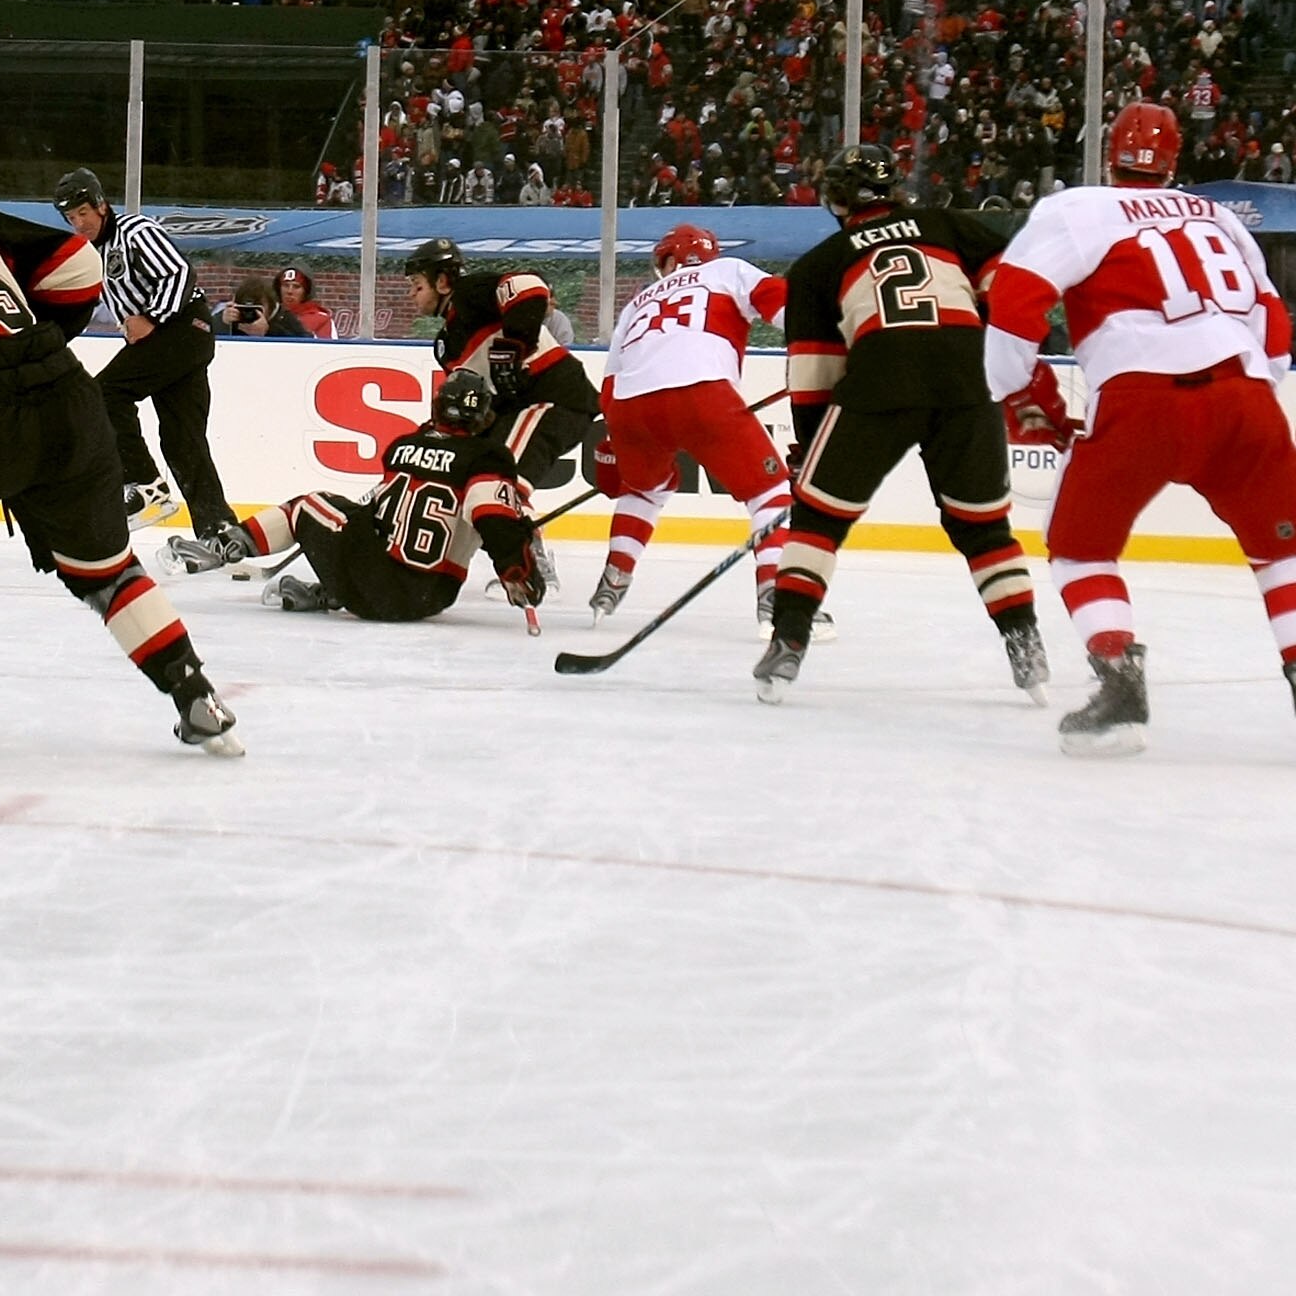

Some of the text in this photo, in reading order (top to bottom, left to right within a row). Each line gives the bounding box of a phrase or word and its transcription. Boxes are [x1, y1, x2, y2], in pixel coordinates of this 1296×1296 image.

[876, 162, 889, 179] 2
[1137, 149, 1154, 164] 18
[850, 219, 921, 250] KEITH
[284, 268, 296, 282] D
[1137, 219, 1257, 323] 18
[870, 245, 939, 329] 2
[462, 393, 479, 408] 46
[390, 445, 456, 473] FRASER
[375, 472, 459, 565] 46
